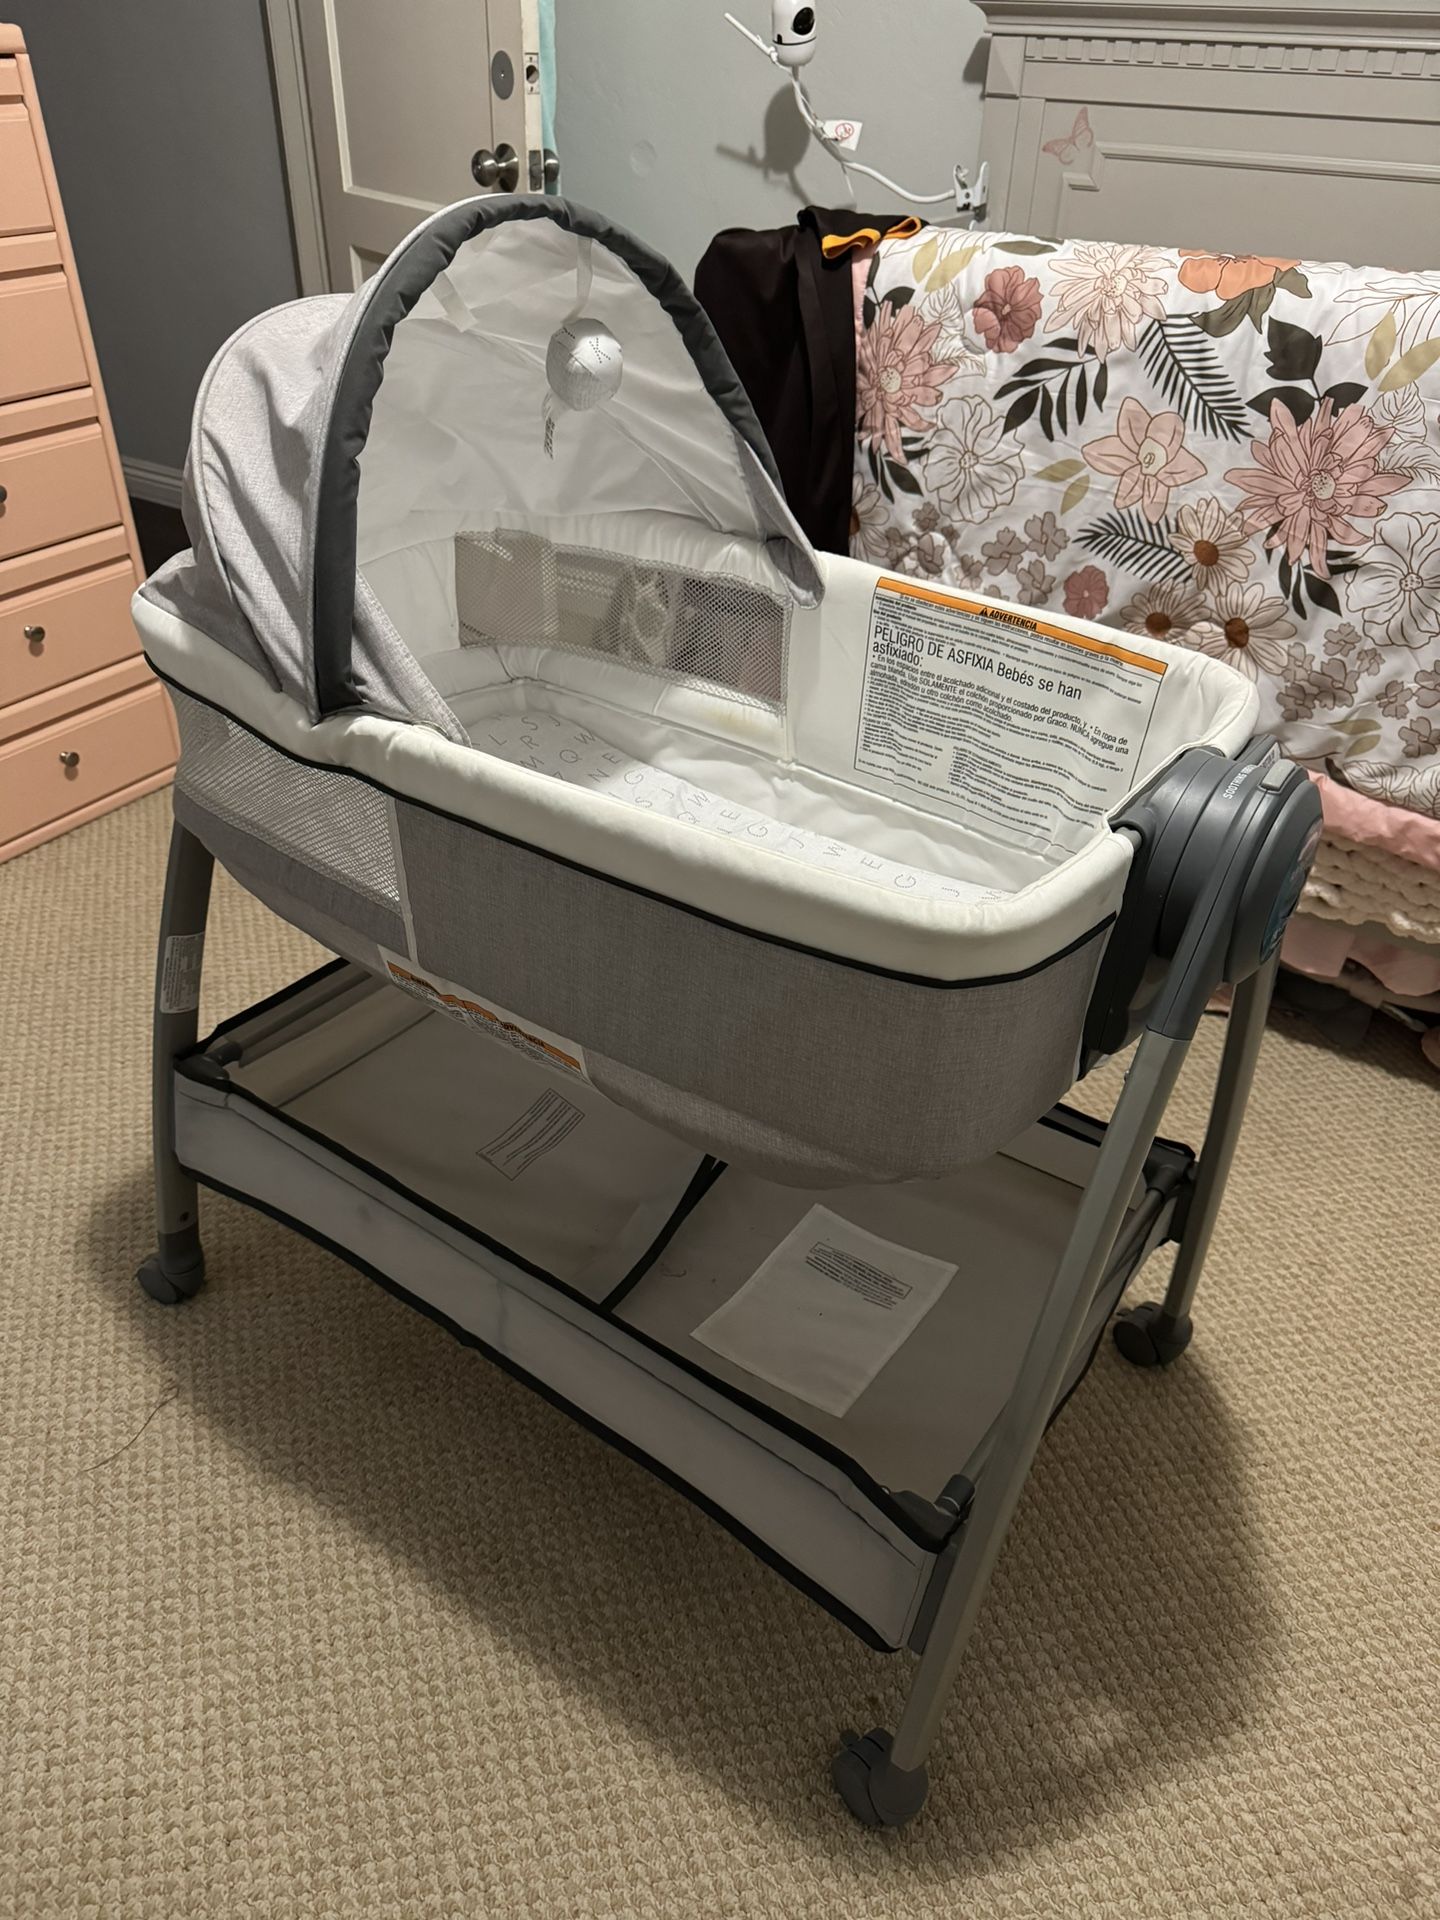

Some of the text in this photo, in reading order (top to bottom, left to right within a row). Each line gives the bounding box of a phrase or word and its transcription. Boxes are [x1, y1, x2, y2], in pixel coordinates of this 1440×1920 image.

[989, 609, 1038, 631] ADVERTENCIA
[872, 641, 924, 668] asfixiado:
[874, 625, 924, 653] PELIGRO
[927, 641, 945, 659] DE
[946, 647, 994, 673] ASFIXIA
[996, 661, 1035, 687] Bebés
[1037, 678, 1054, 693] se
[1057, 680, 1082, 700] han
[877, 654, 886, 662] En
[1012, 698, 1040, 713] costado
[1040, 706, 1052, 716] del
[918, 676, 958, 694] SOLAMENTE
[958, 688, 965, 696] el
[1032, 713, 1046, 723] por
[1070, 722, 1090, 740] NUNCA
[1089, 735, 1114, 751] agregue
[1114, 746, 1130, 755] una
[520, 735, 540, 750] R
[1093, 726, 1128, 746] En ropa de
[559, 749, 583, 763] Q
[624, 769, 644, 785] G
[1222, 772, 1248, 800] SOOTHING
[746, 822, 769, 838] G
[894, 873, 917, 889] G
